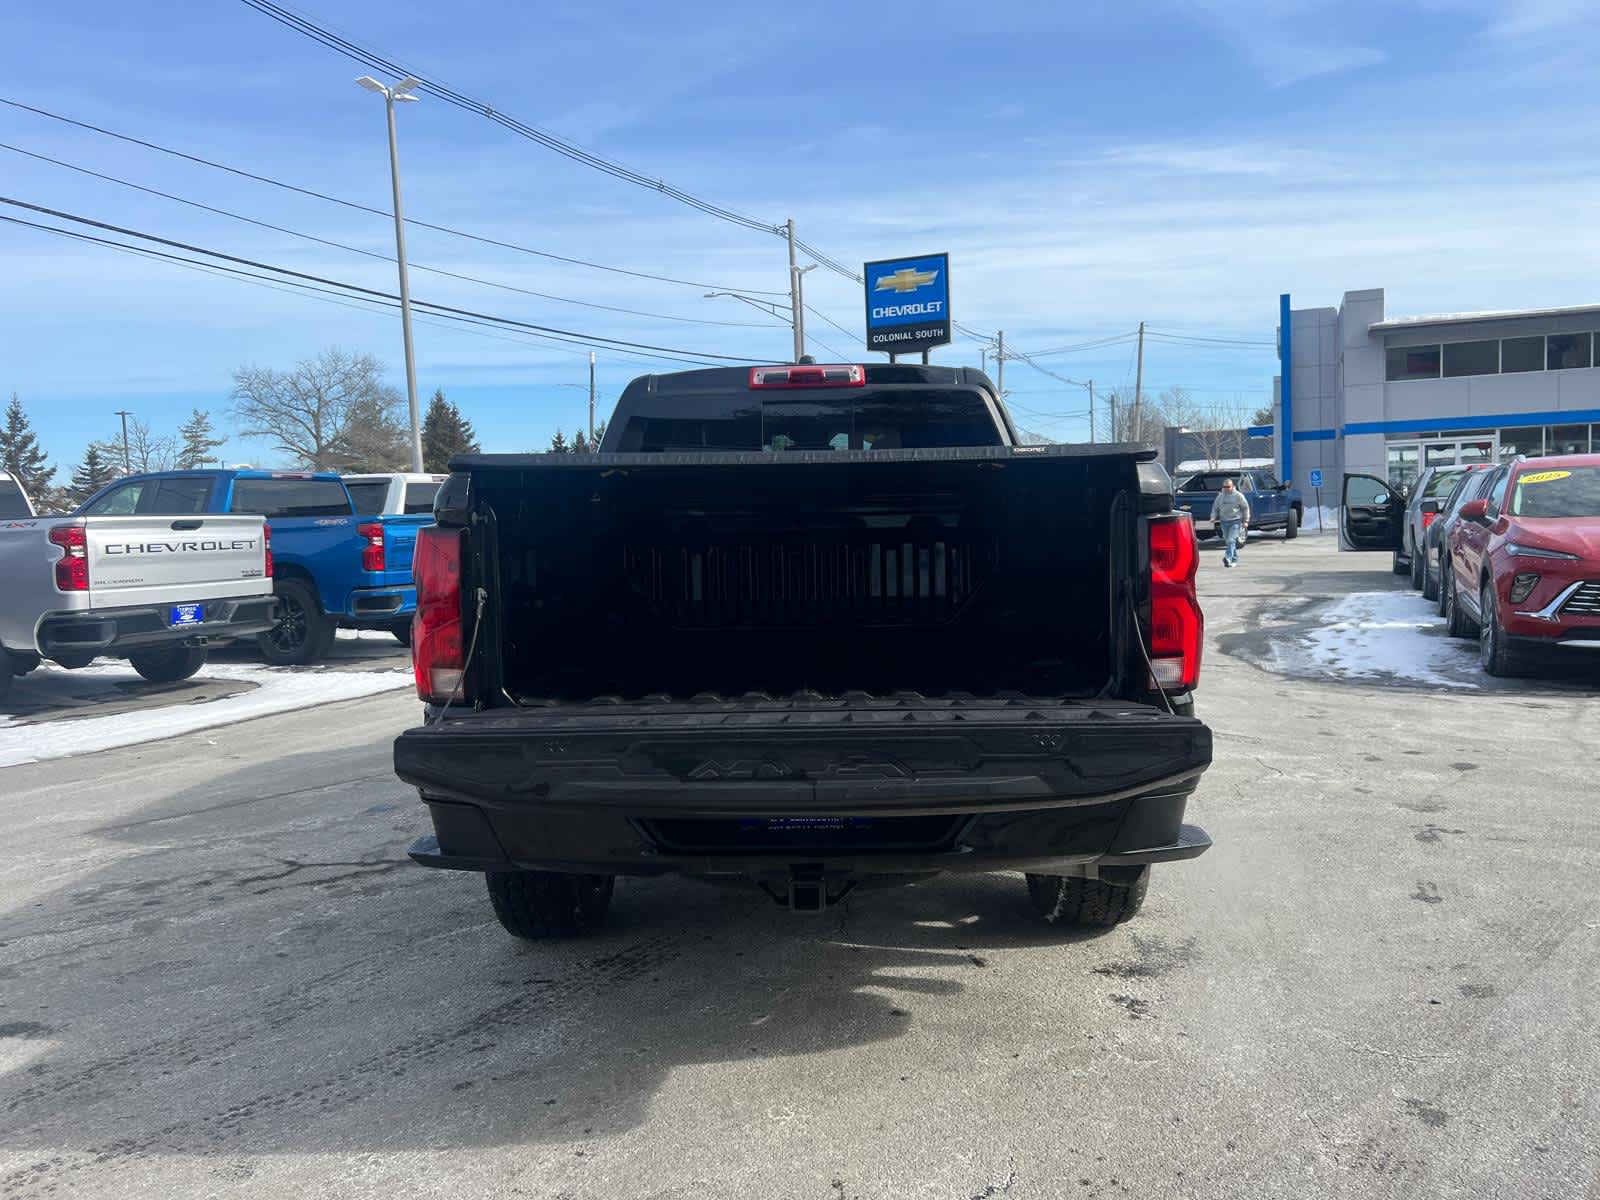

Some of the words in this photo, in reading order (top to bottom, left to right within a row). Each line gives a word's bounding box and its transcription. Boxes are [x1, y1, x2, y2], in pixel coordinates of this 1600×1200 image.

[872, 301, 943, 319] CHEVROLET
[873, 331, 913, 343] COLONIAL
[915, 328, 944, 339] SOUTH
[105, 540, 256, 555] CHEVROLET
